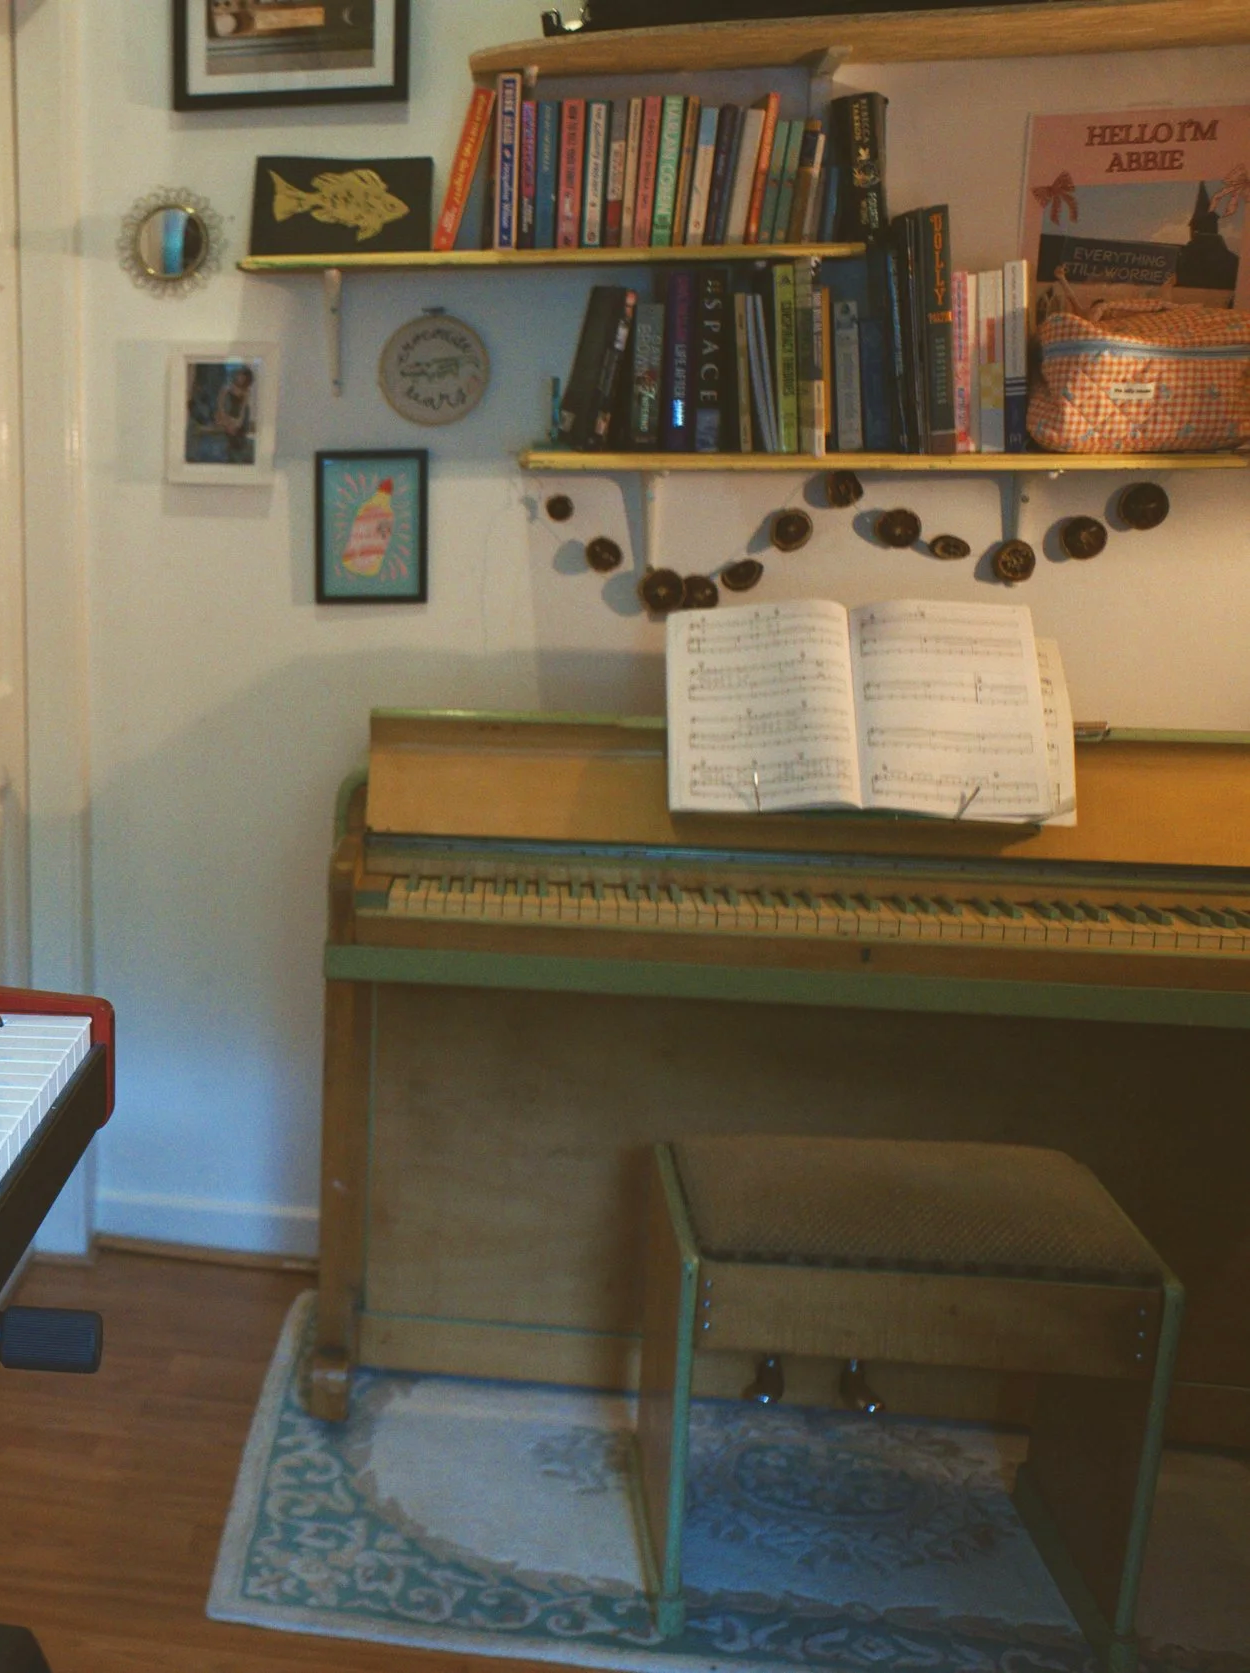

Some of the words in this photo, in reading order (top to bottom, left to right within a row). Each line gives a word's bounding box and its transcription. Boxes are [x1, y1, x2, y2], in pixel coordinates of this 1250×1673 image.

[661, 99, 683, 160] HARLAN
[859, 98, 871, 143] REBECCA
[1085, 123, 1174, 147] HELLO
[1175, 119, 1219, 142] I'M
[1105, 149, 1185, 173] ABBIE
[657, 162, 675, 216] COBEN
[929, 212, 946, 306] DOLLY
[1062, 261, 1104, 278] STILL
[1073, 246, 1167, 267] EVERYTHING
[700, 297, 723, 402] SPACE
